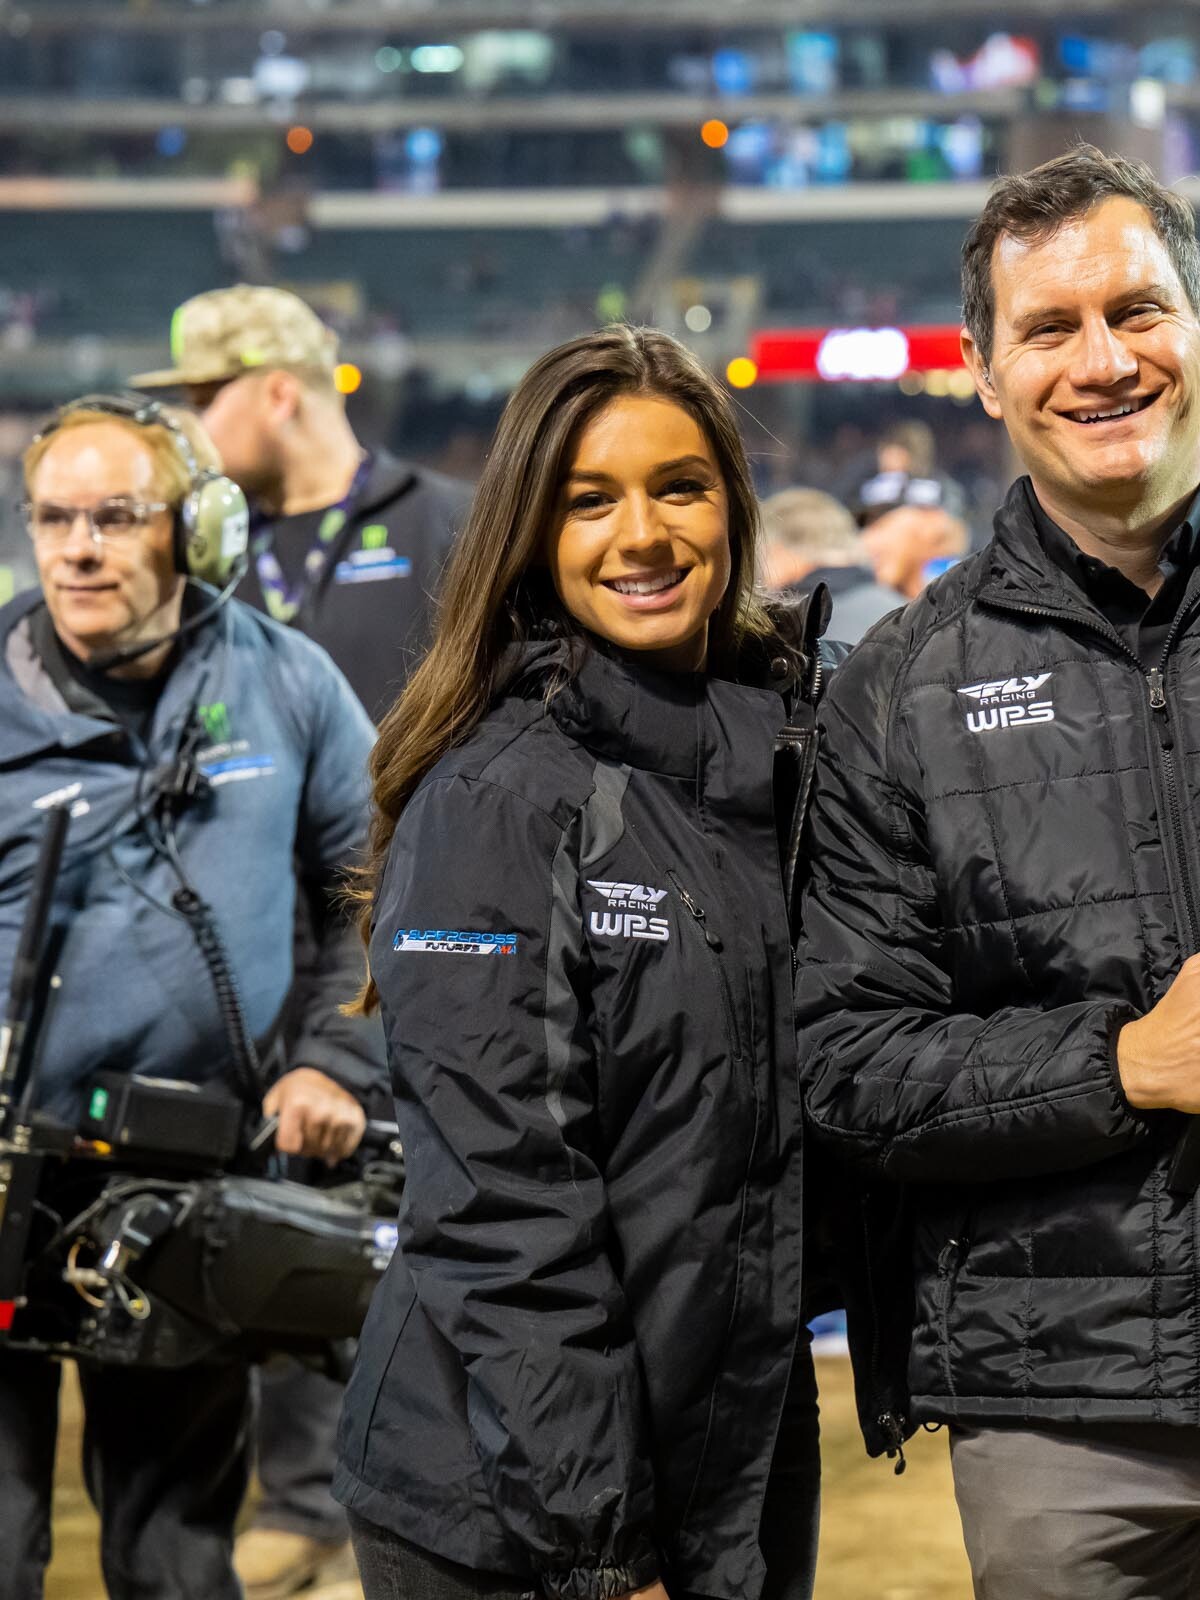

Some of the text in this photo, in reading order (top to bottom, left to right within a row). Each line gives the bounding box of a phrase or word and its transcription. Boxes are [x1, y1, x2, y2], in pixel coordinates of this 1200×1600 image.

[957, 672, 1052, 699] FLY
[980, 691, 1036, 705] RACING
[966, 701, 1055, 733] WPS
[587, 880, 668, 903] FLY
[608, 899, 657, 911] RACING
[590, 911, 669, 941] WPS
[408, 929, 517, 944] SUPERCROSS
[425, 941, 480, 953] FUTURES
[492, 944, 516, 955] AMA
